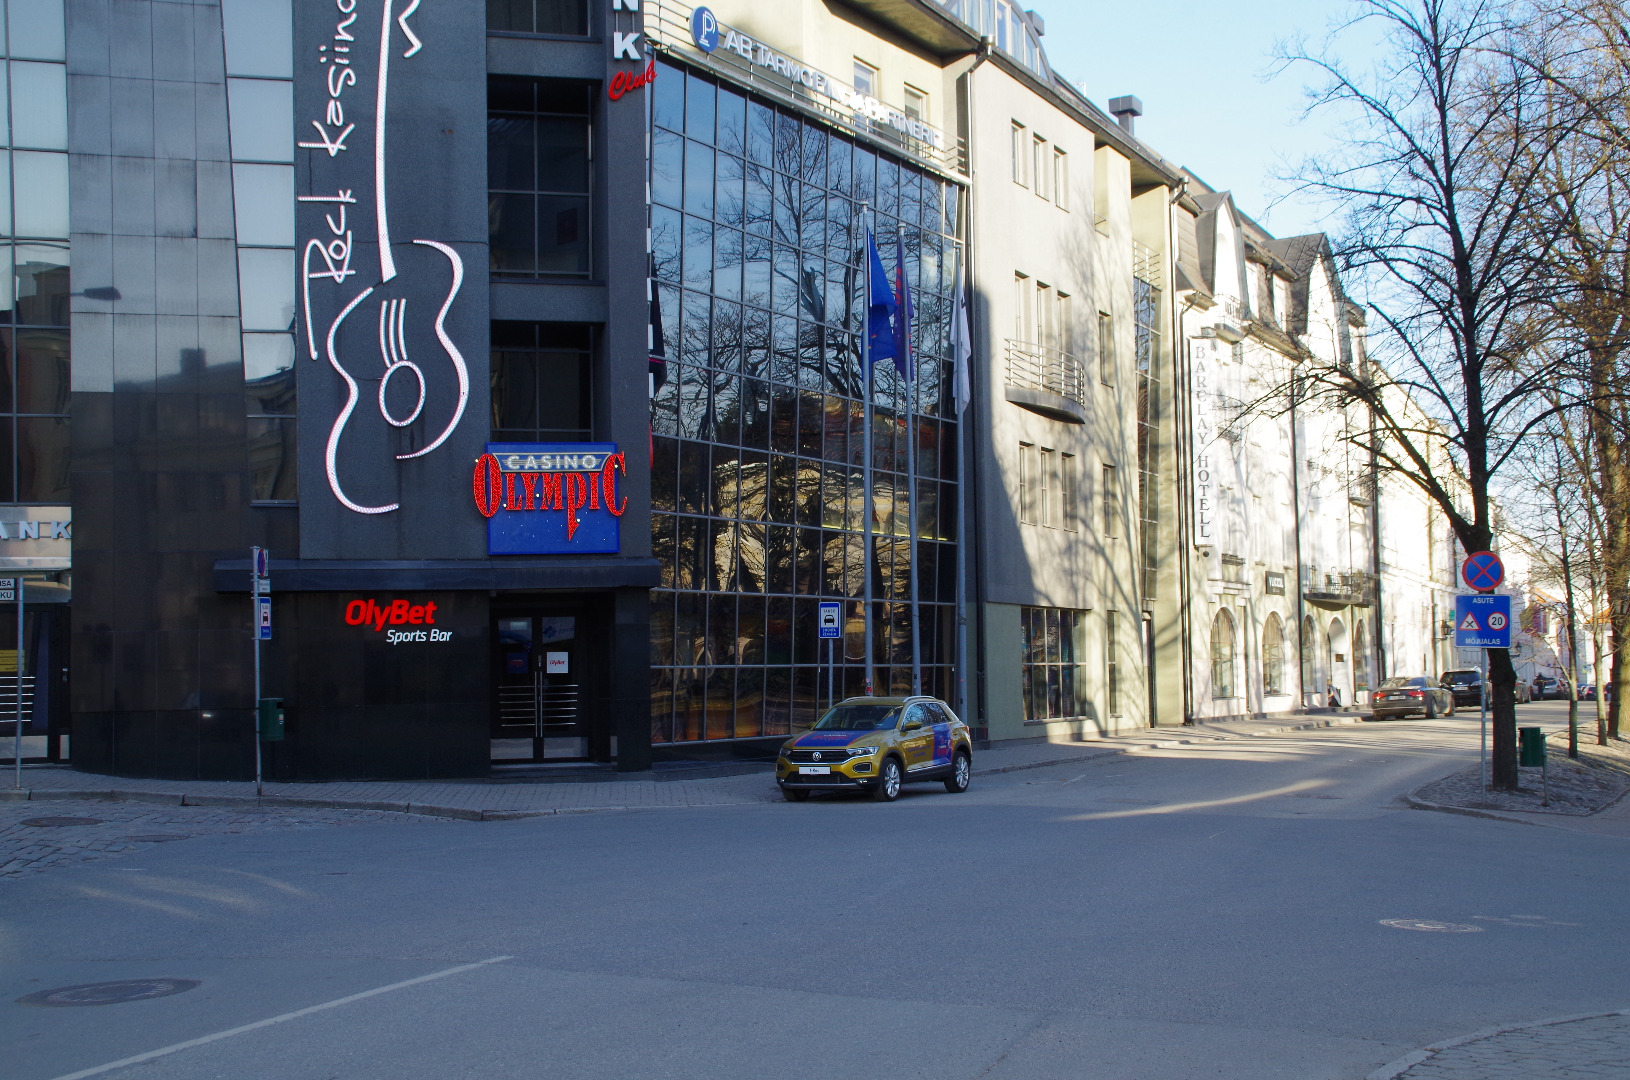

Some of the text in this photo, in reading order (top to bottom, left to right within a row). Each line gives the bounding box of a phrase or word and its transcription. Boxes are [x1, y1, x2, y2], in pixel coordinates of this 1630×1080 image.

[723, 30, 753, 60] AB
[754, 42, 813, 88] TARMO
[608, 59, 657, 100] Club
[297, 189, 356, 360] Rock
[1195, 346, 1210, 538] BARCLAY HOTELL
[507, 455, 597, 469] CASINO
[345, 598, 438, 632] OlyBet
[1491, 616, 1503, 626] 20
[386, 628, 452, 645] Sports Bar
